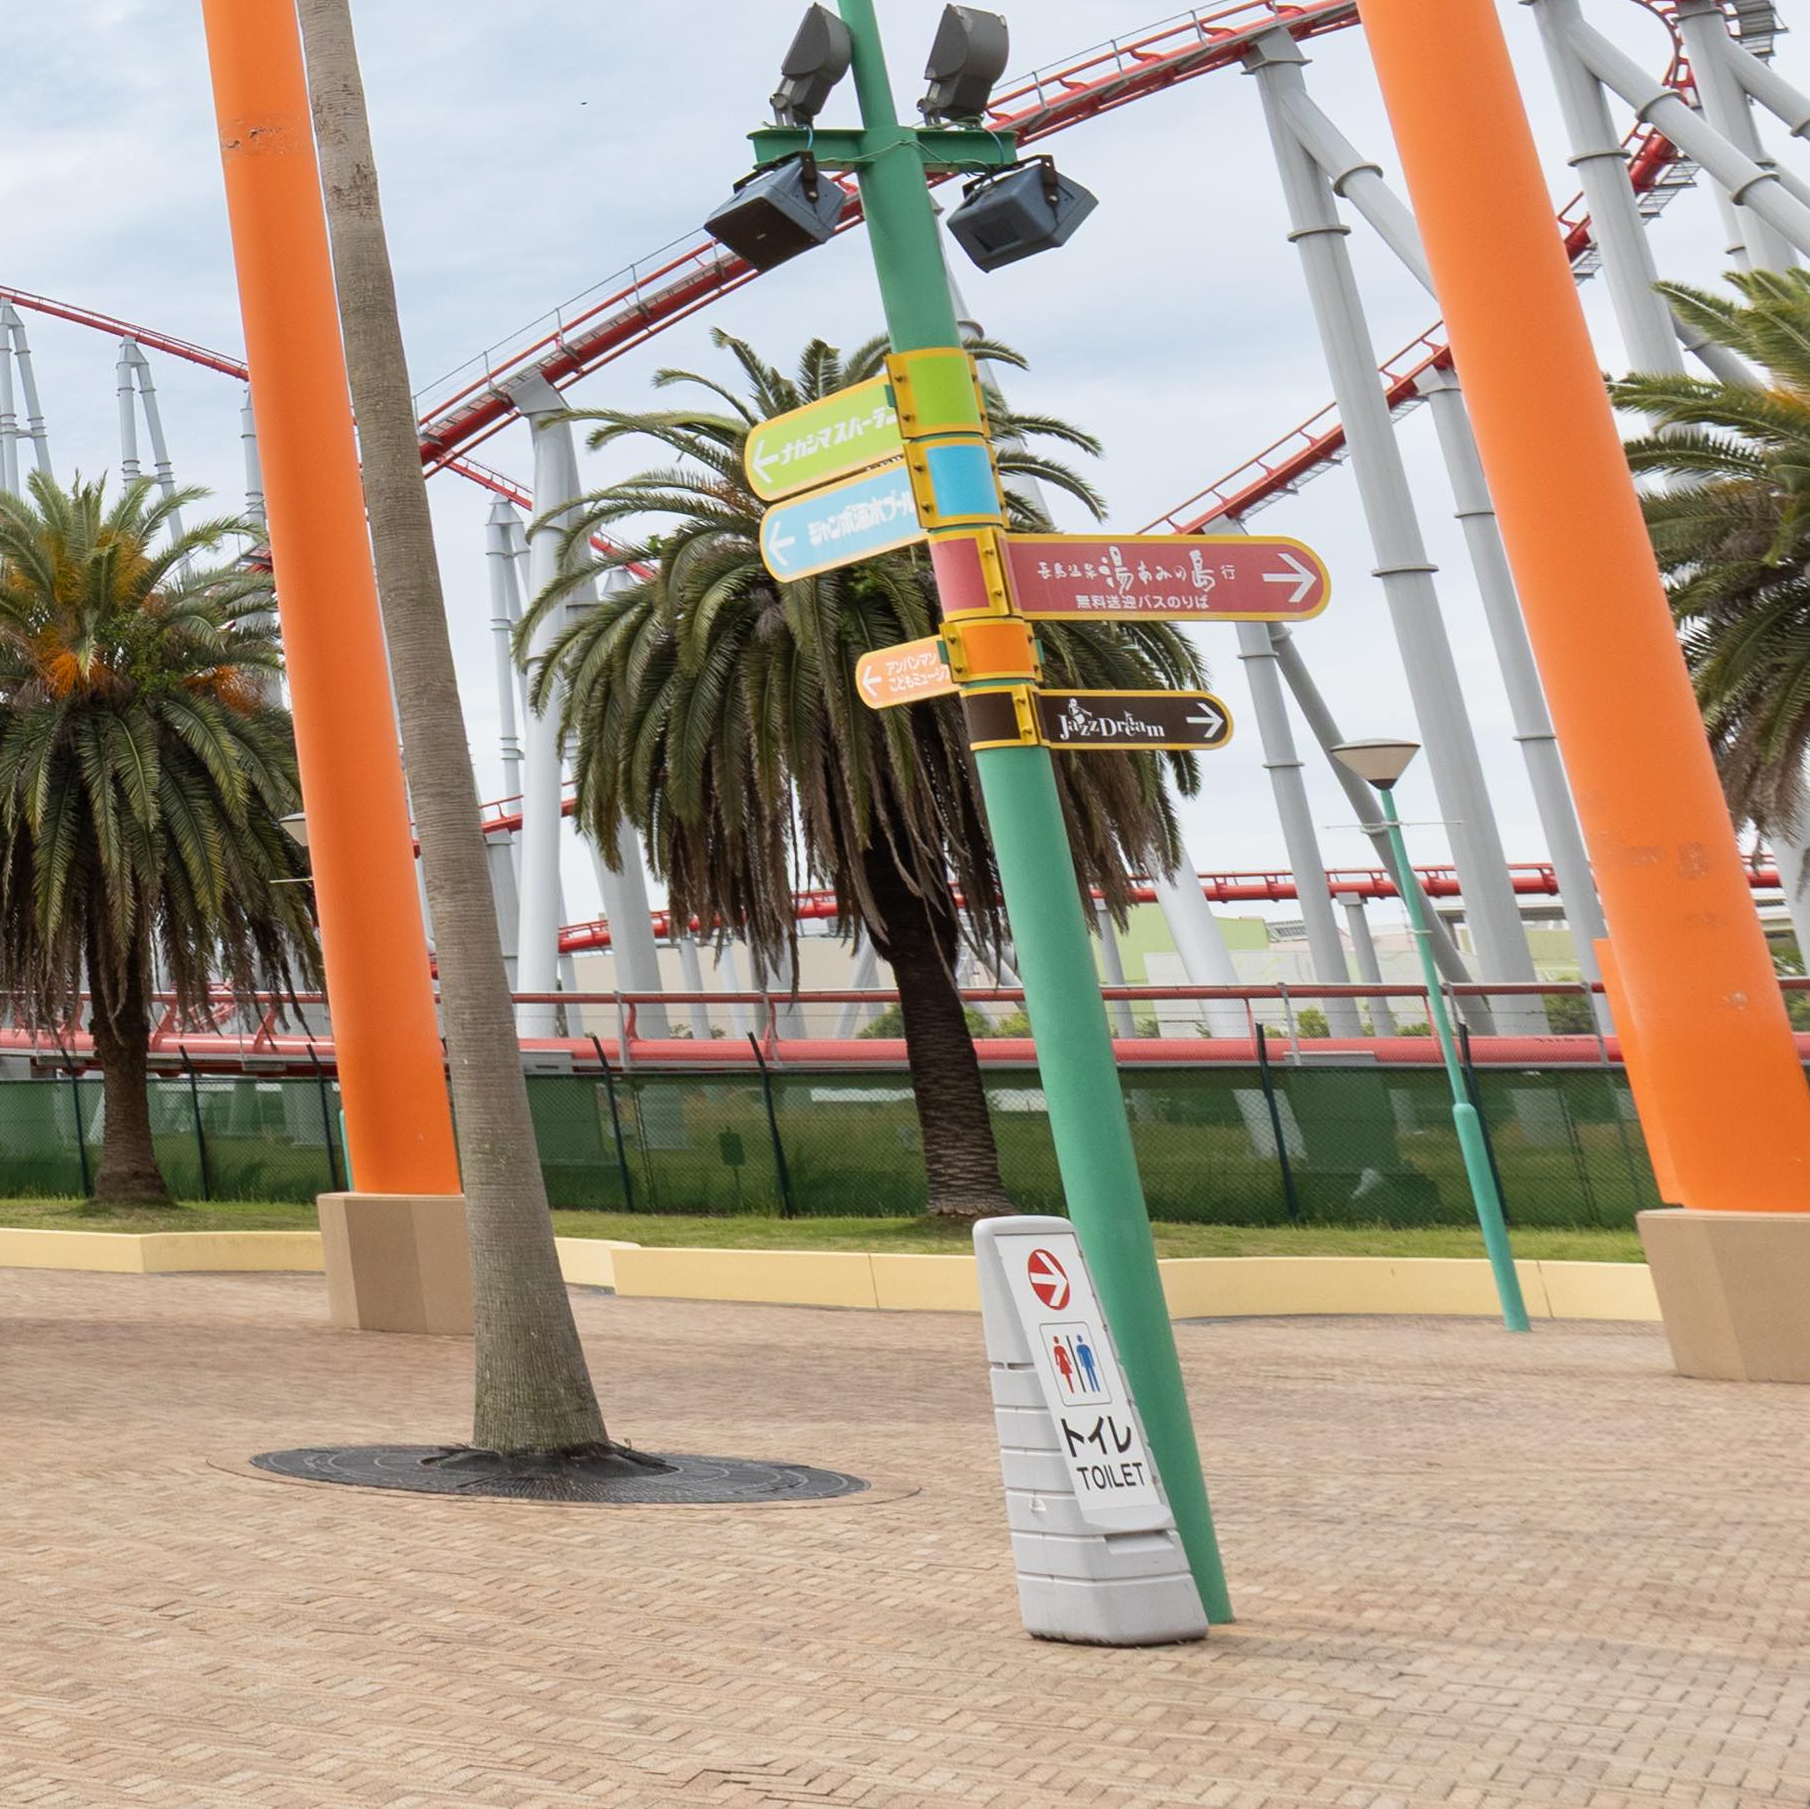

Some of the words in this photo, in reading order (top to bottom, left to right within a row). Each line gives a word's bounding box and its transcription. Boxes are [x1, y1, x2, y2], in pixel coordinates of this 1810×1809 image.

[1075, 594, 1210, 610] 無料送迎バスのりば
[885, 653, 937, 675] アンパンマン
[1059, 1415, 1132, 1458] トイレ
[1076, 1461, 1144, 1491] TOILET
